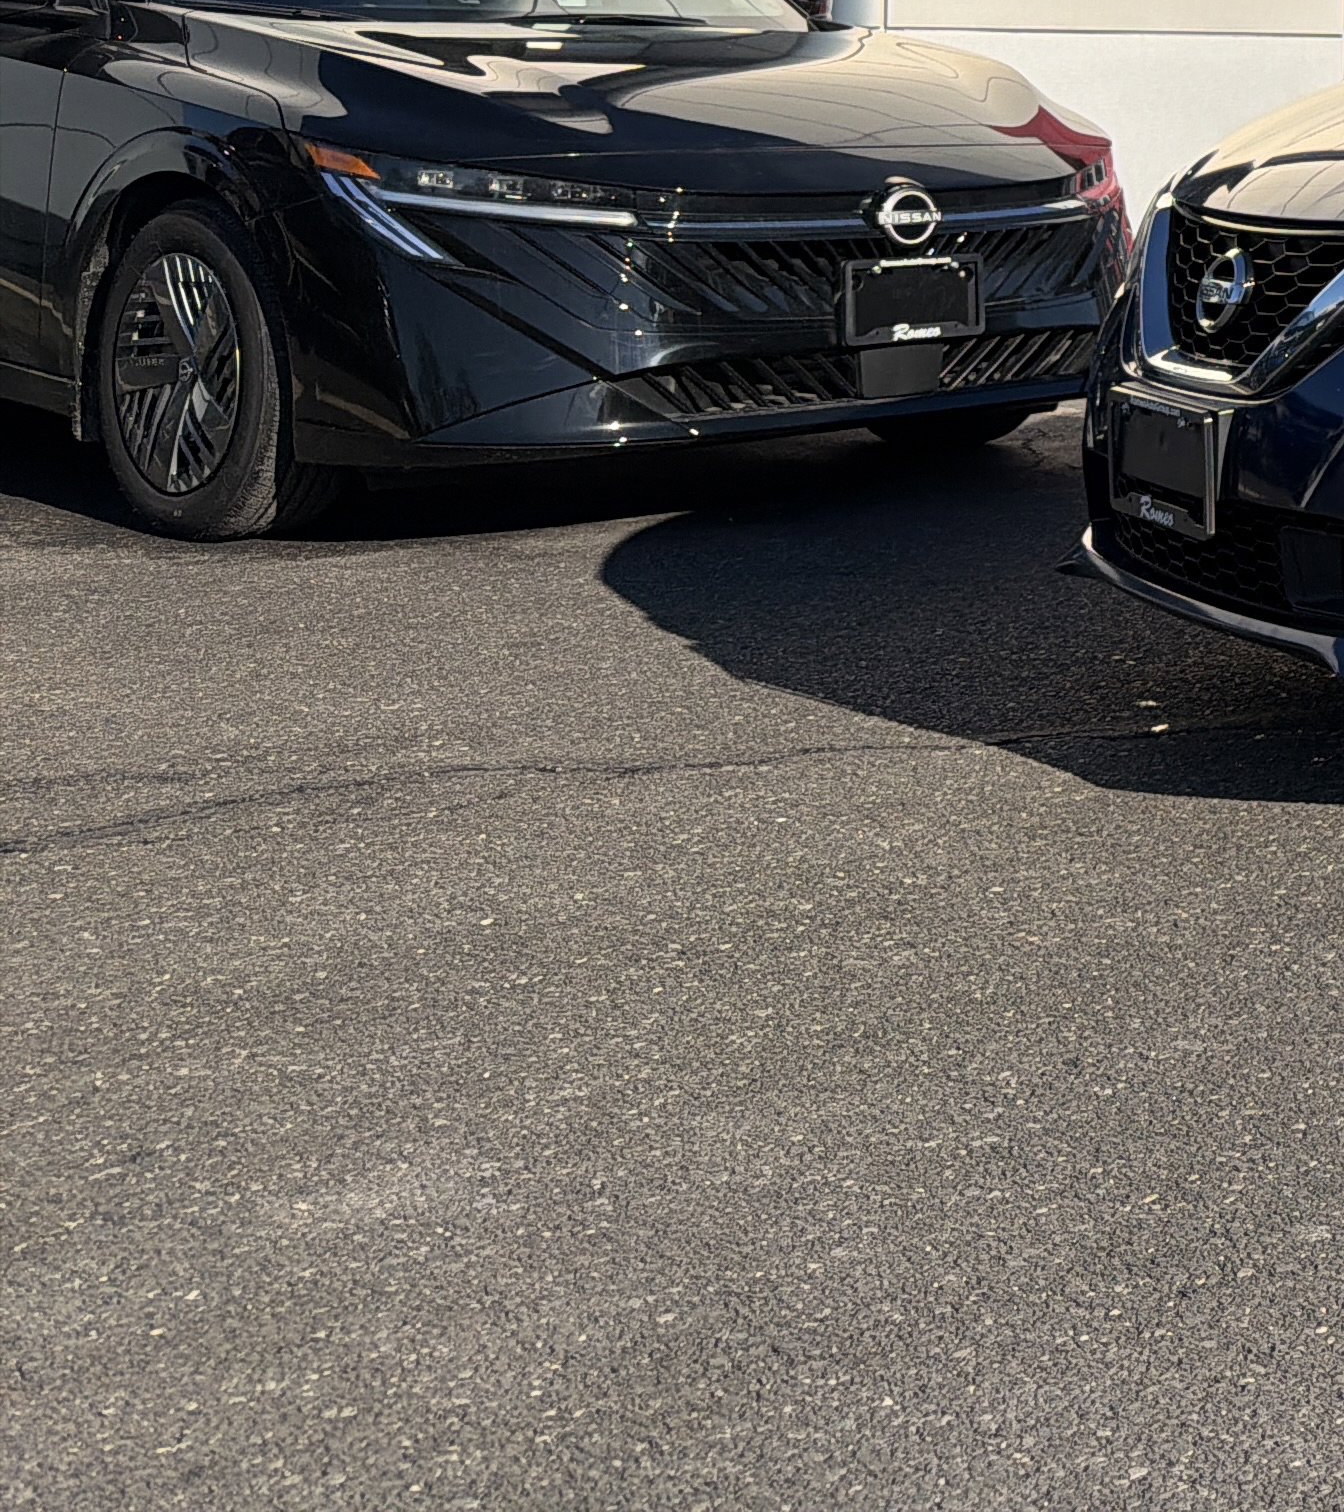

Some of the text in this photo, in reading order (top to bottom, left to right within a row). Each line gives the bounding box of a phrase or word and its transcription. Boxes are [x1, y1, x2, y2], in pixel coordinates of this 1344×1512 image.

[879, 211, 942, 226] NISSAN
[892, 323, 942, 342] Romeo
[1139, 495, 1174, 528] Romeo
